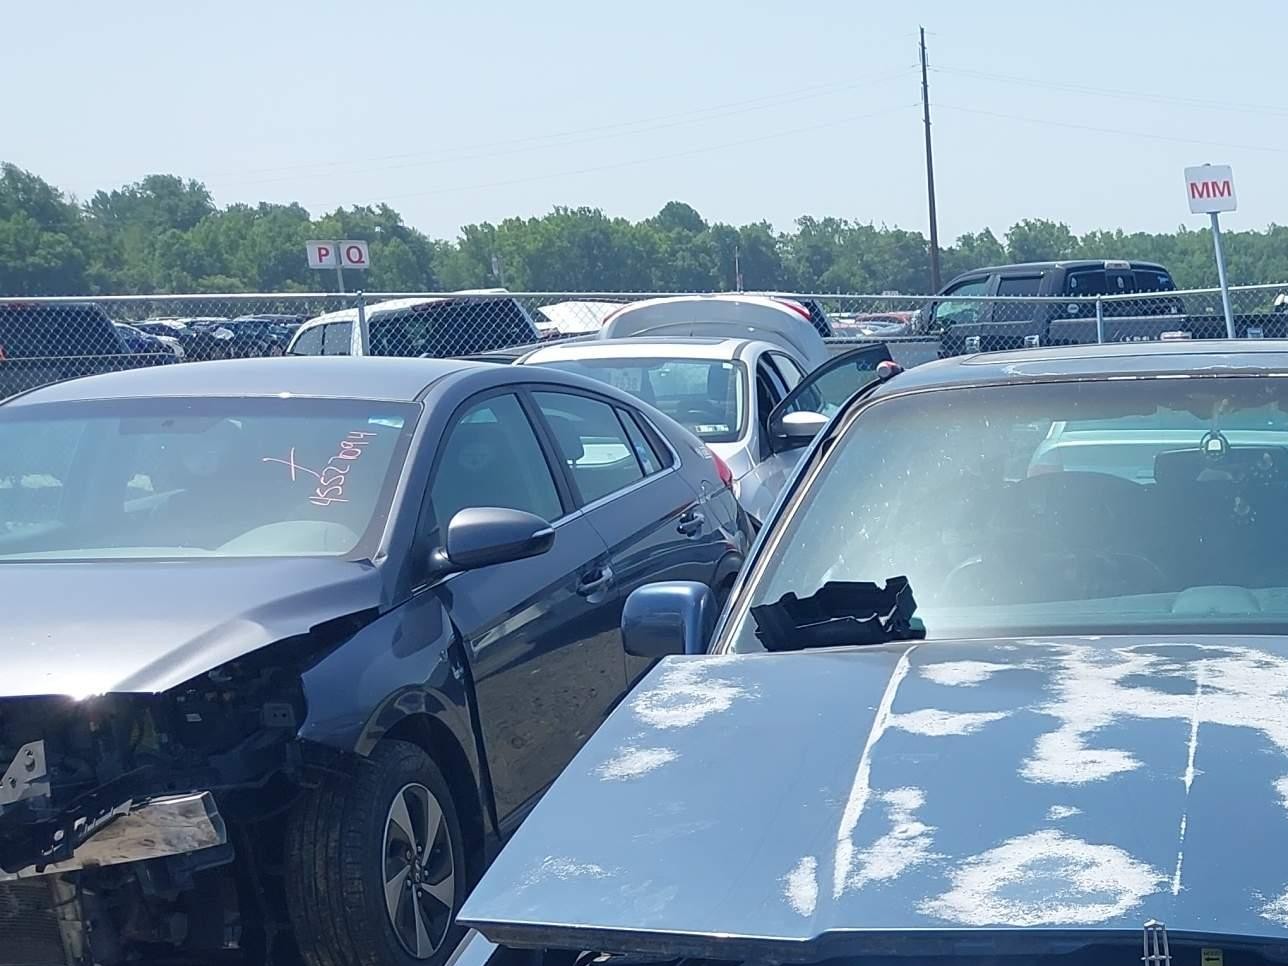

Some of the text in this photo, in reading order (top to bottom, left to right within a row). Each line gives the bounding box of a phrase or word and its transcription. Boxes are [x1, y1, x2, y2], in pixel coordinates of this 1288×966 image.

[1190, 181, 1232, 199] MM
[317, 246, 330, 264] P
[346, 245, 365, 264] Q
